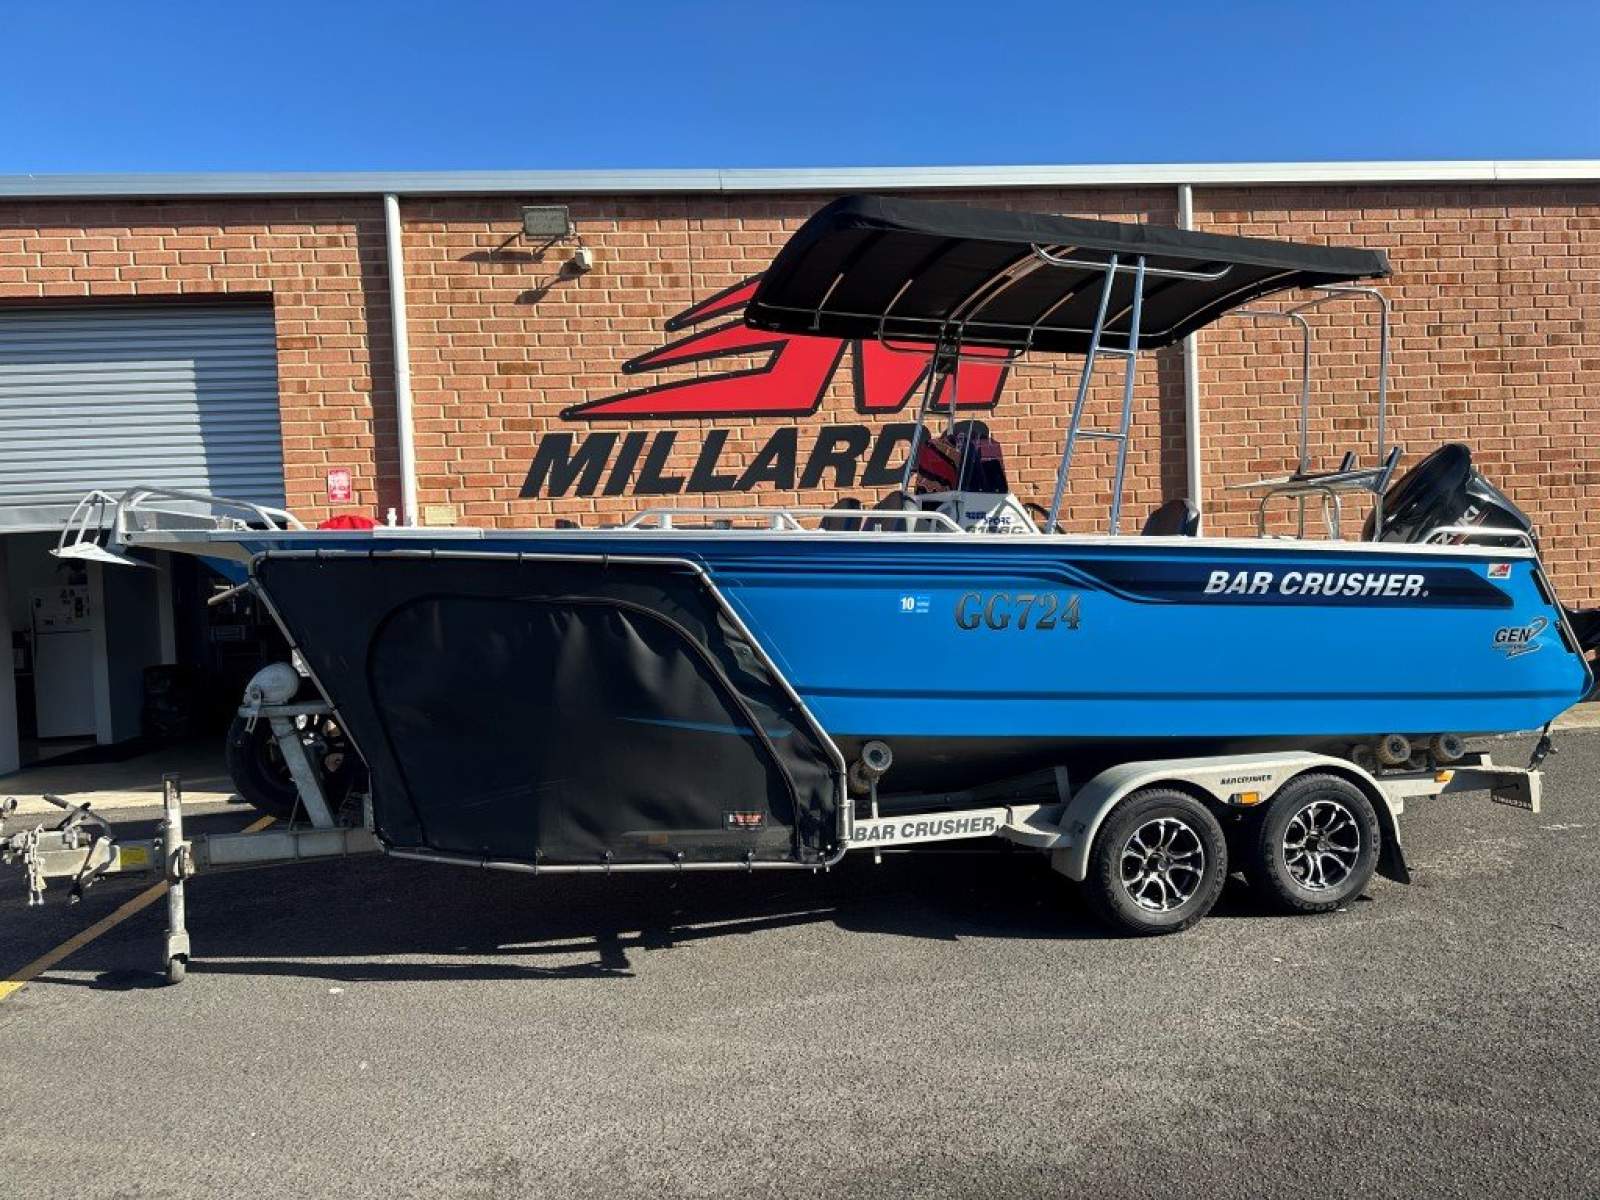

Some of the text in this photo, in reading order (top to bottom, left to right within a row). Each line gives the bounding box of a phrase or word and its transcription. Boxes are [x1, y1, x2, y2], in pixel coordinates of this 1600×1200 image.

[1203, 570, 1424, 597] BAR CRUSHER
[900, 596, 915, 611] 10
[955, 592, 1081, 631] GG724
[854, 816, 996, 842] BAR CRUSHER
